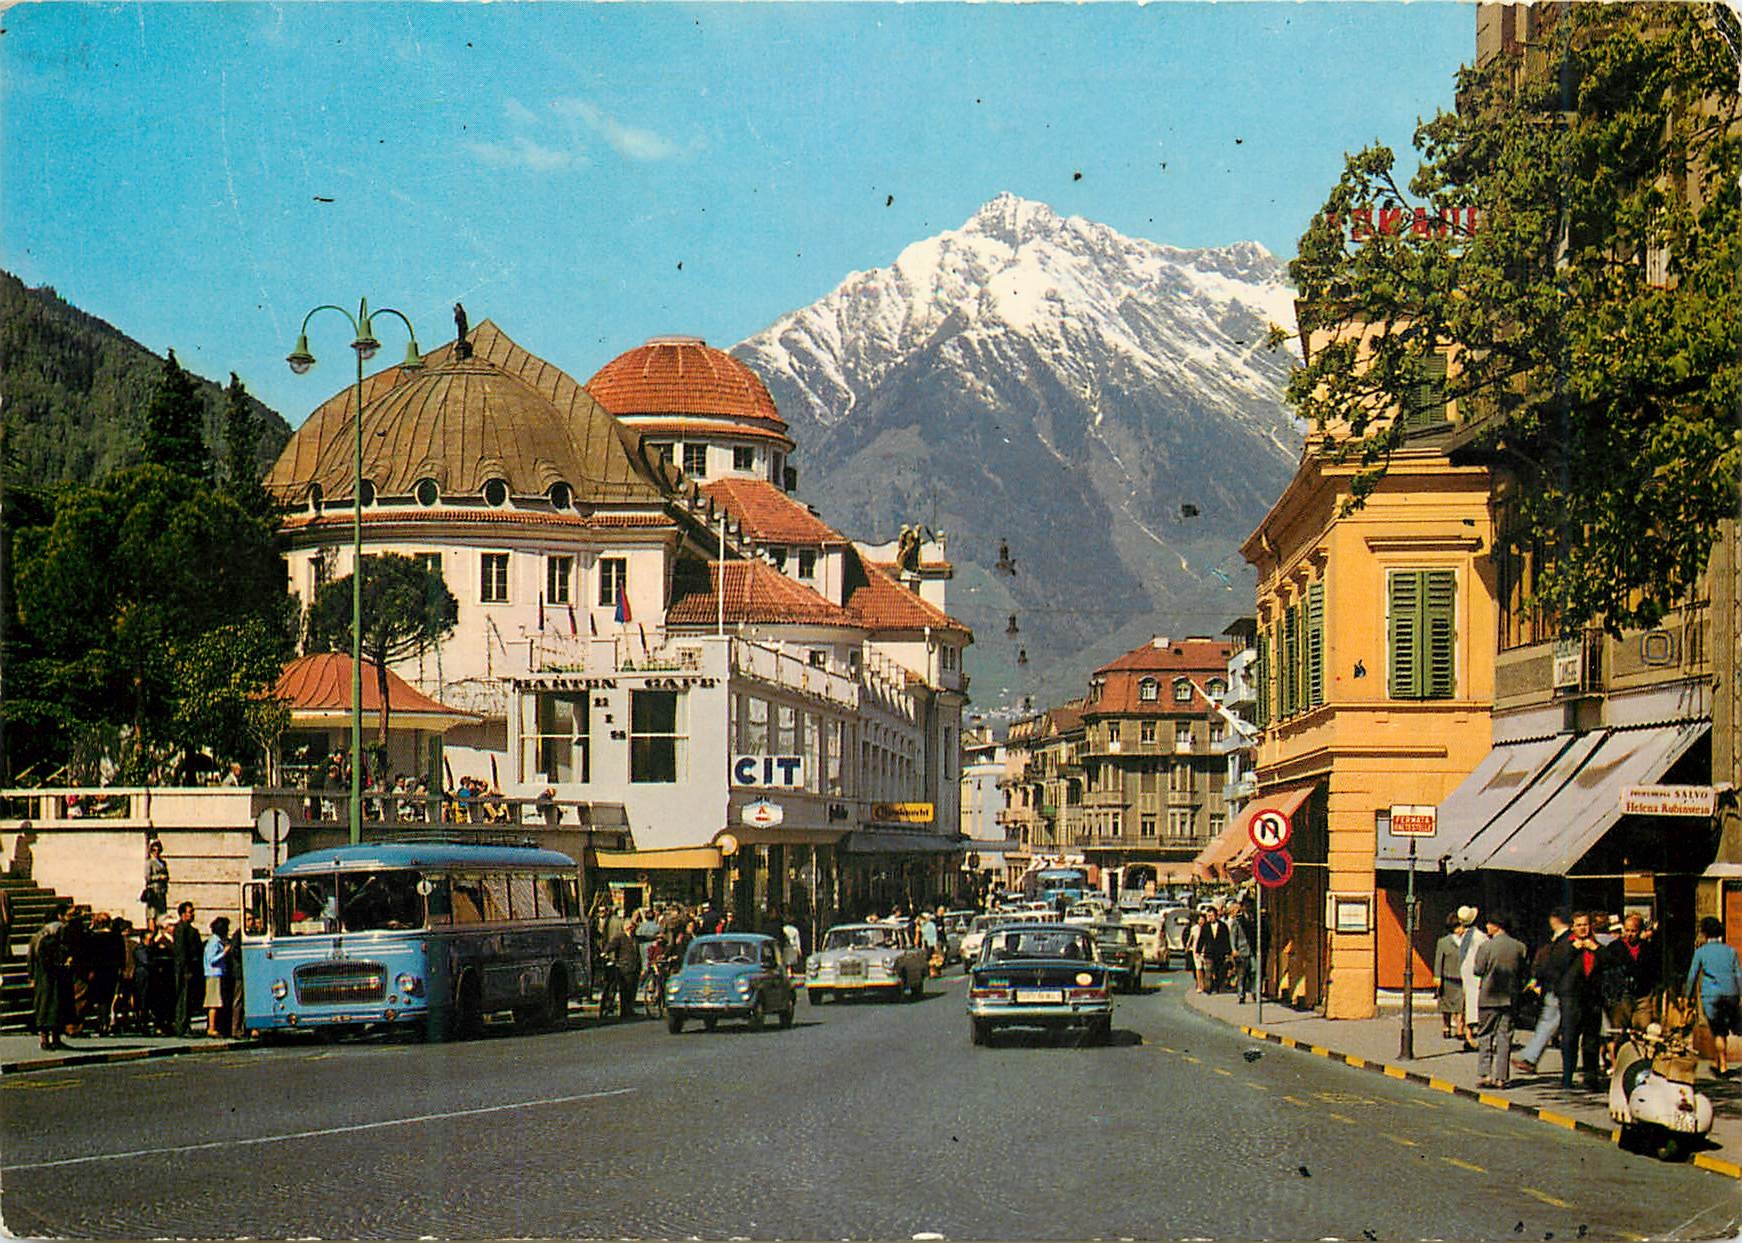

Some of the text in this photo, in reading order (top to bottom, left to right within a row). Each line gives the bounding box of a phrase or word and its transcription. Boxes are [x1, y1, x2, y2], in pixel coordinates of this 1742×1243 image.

[734, 757, 799, 784] CIT
[1674, 790, 1707, 799] SALVO
[1627, 802, 1657, 812] Helena
